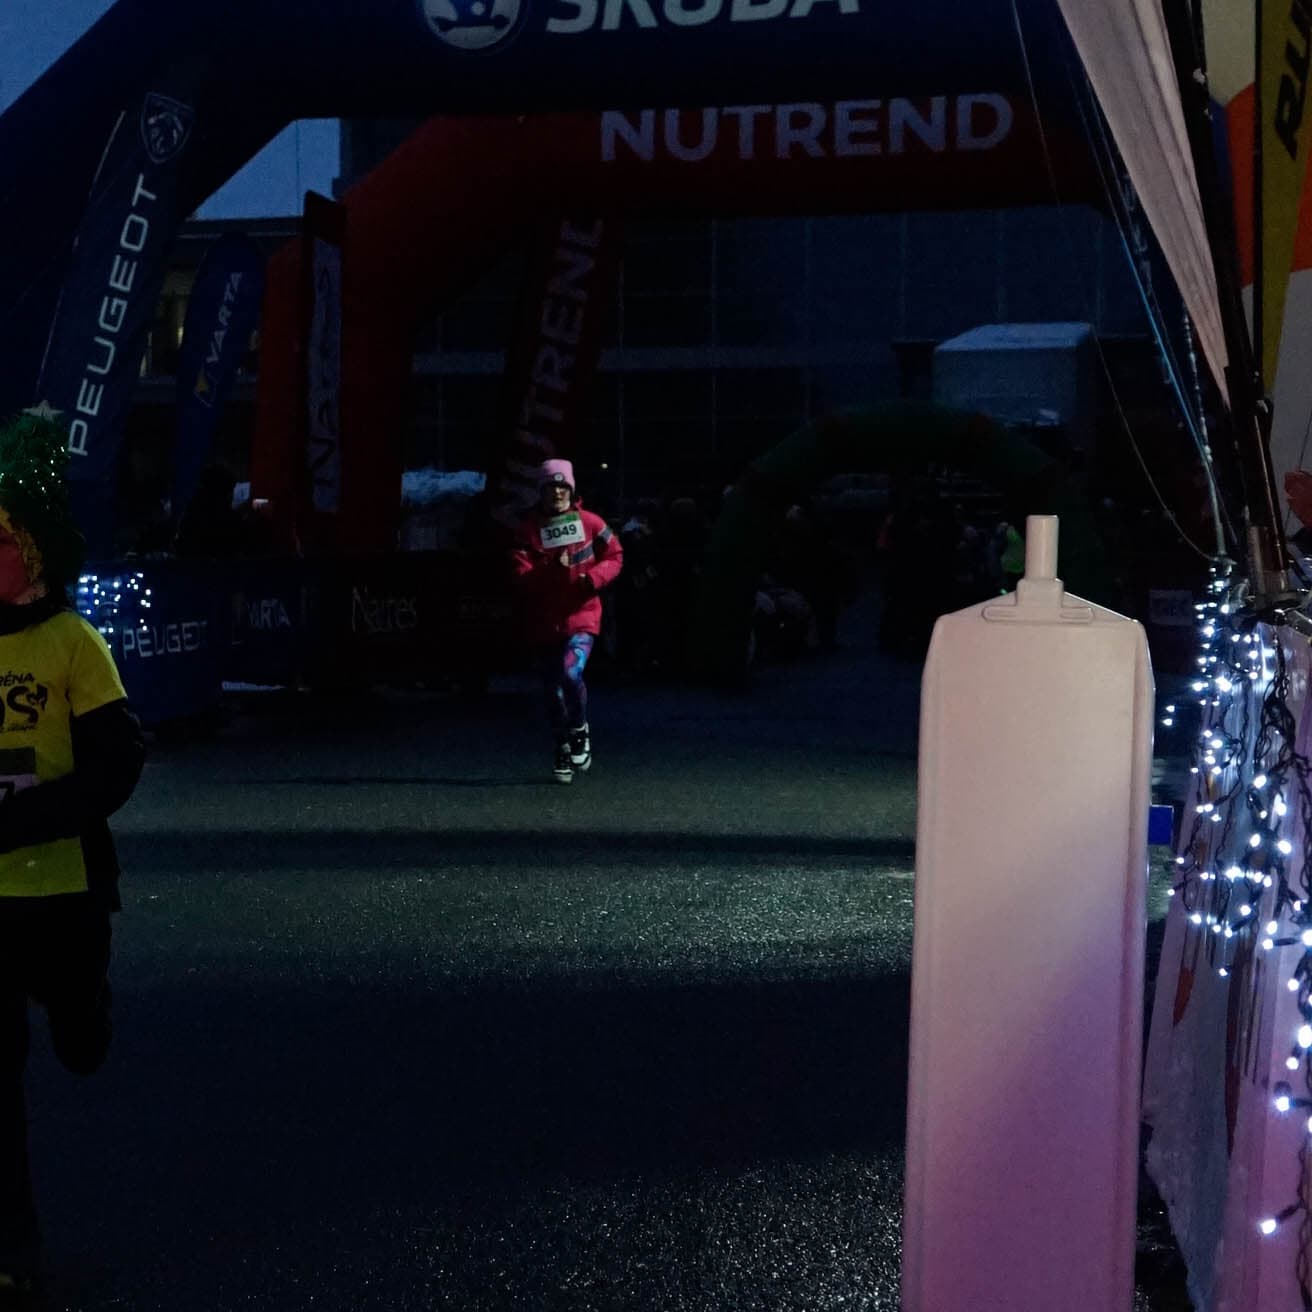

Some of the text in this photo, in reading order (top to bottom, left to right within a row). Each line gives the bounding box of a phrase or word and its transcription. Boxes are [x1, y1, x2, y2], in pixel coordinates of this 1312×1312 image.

[600, 92, 1015, 162] NUTREND
[68, 173, 157, 456] PEUGEOT
[544, 524, 577, 541] 3049
